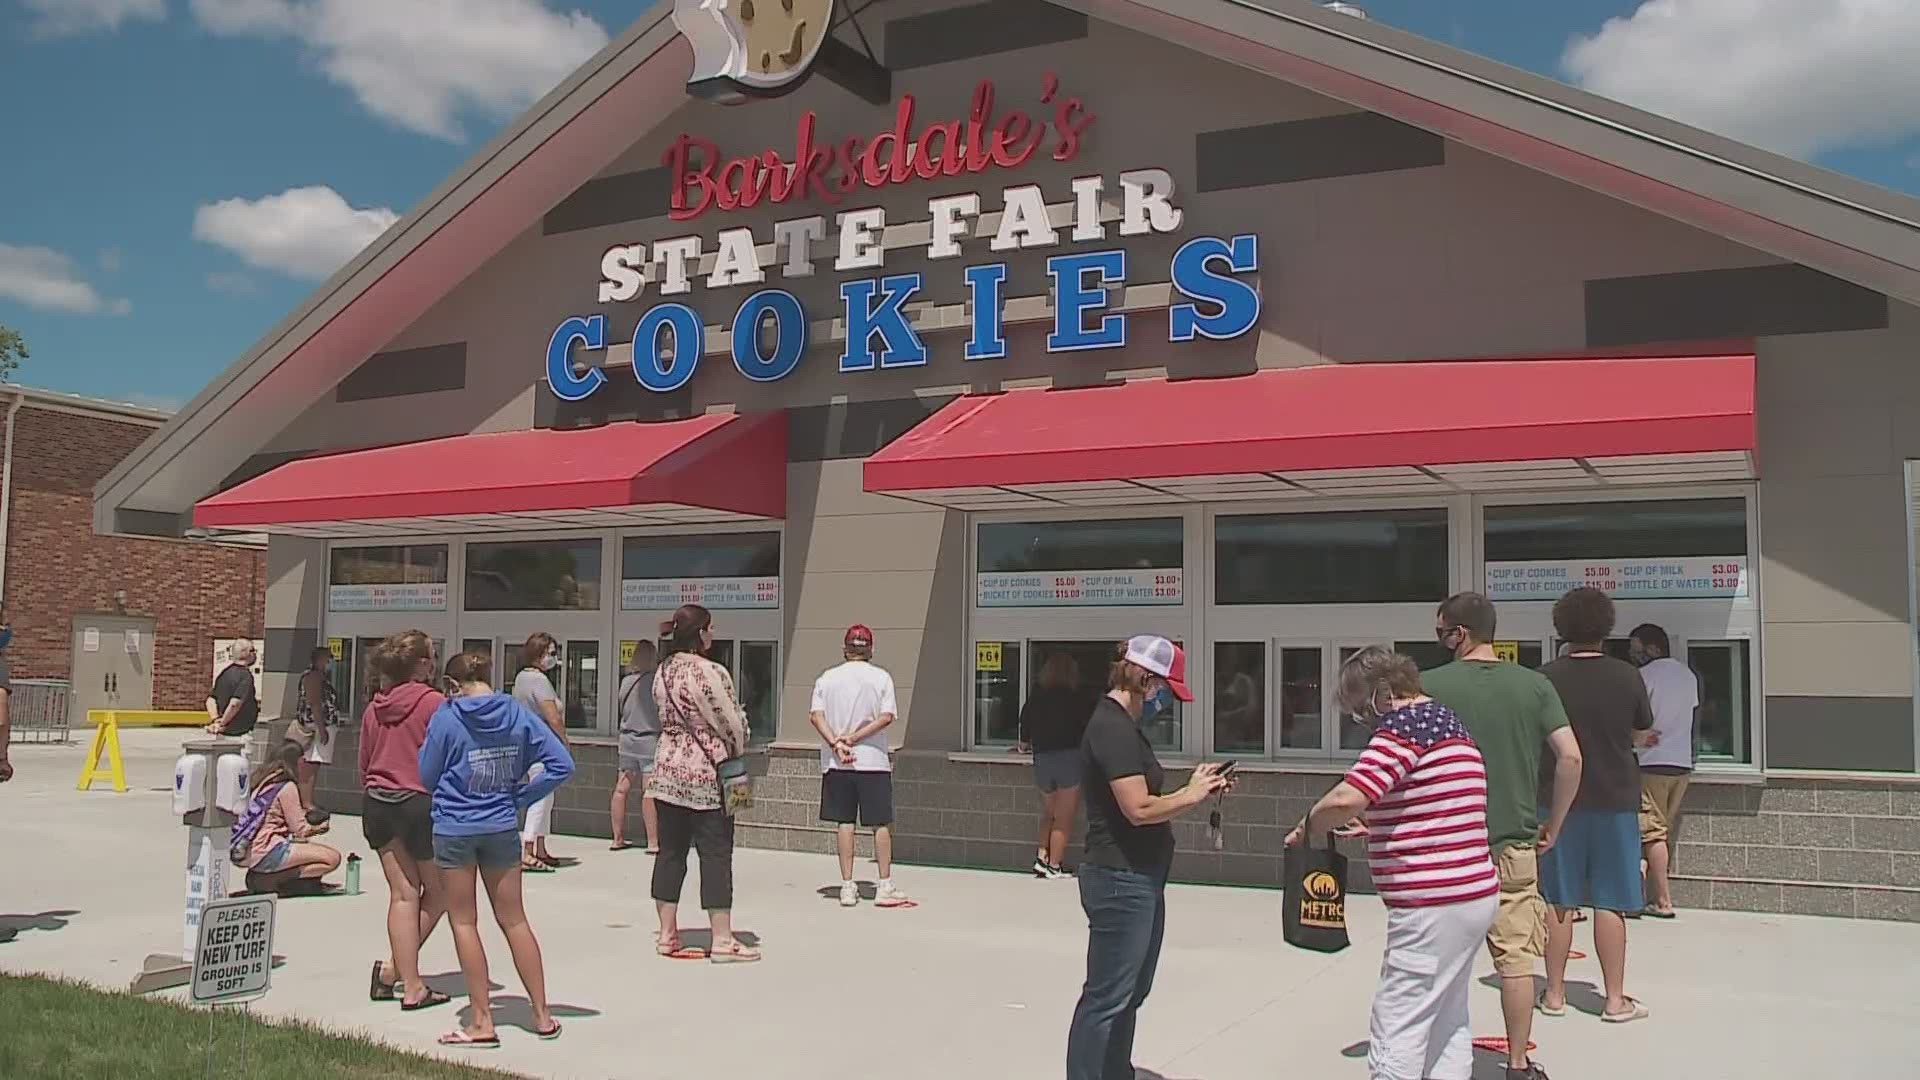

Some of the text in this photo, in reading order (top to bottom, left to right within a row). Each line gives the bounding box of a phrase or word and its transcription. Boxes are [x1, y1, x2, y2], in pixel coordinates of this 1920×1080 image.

[660, 69, 1096, 221] Barksdale's
[599, 167, 1184, 303] STATE FAIR
[545, 234, 1262, 401] COOKIES
[1492, 567, 1610, 578] CUP OF COOKIES $5.00
[1623, 564, 1739, 576] CUP OF MILK $3.00
[1010, 577, 1041, 587] COOKIES
[1055, 576, 1076, 586] $5.00
[1114, 576, 1134, 585] MILK
[1155, 575, 1176, 584] $3.00
[1623, 578, 1739, 589] BOTTLE OF WATER $3.00
[1127, 588, 1154, 597] WATER
[1155, 587, 1176, 597] $3.00
[1492, 582, 1528, 592] BUCKET
[1529, 581, 1541, 592] OF
[1055, 589, 1080, 598] $15.00
[986, 651, 993, 662] 6
[217, 906, 260, 923] PLEASE
[207, 921, 266, 946] KEEP OFF
[202, 940, 266, 966] NEW TURF
[201, 962, 262, 981] GROUND IS
[217, 977, 245, 991] SOFT
